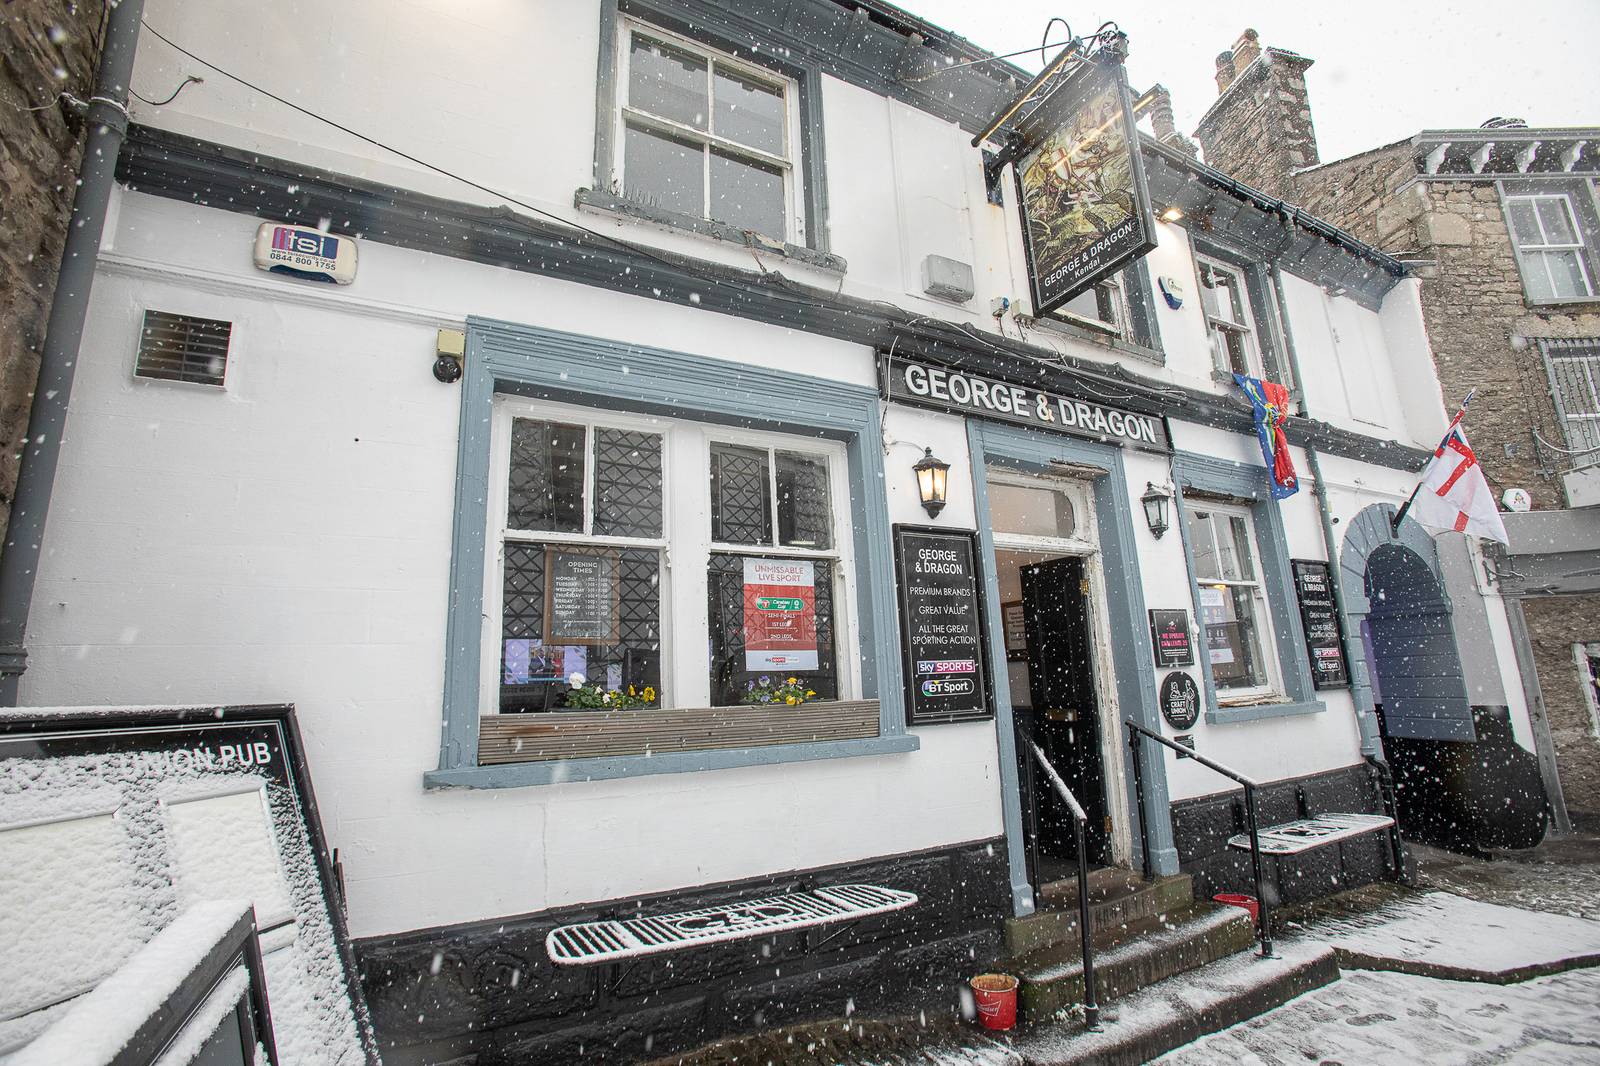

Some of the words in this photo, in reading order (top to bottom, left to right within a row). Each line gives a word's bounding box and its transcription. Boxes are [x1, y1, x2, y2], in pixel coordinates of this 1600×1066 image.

[288, 231, 325, 257] tsi
[270, 252, 292, 262] 0844
[295, 257, 312, 266] 800
[315, 261, 336, 271] 1755
[1044, 257, 1081, 287] GEORGE
[1081, 251, 1089, 263] &
[1090, 223, 1133, 257] DRAGON
[1074, 257, 1100, 278] Kendal
[904, 364, 1030, 417] GEORGE
[1035, 393, 1055, 422] &
[1058, 398, 1157, 443] DRAGON
[918, 548, 957, 562] GEORGE
[754, 564, 804, 575] UNMISSABLE
[915, 562, 923, 573] &
[924, 561, 963, 575] DRAGON
[758, 573, 775, 581] LIVE
[776, 574, 801, 582] SPORT
[909, 586, 942, 596] PREMIUM
[943, 587, 971, 597] BRANDS
[918, 606, 943, 615] GREAT
[943, 606, 966, 615] VALUE
[918, 624, 932, 633] ALL
[932, 624, 945, 633] THE
[946, 624, 969, 633] GREAT
[912, 635, 949, 645] SPORTING
[949, 635, 976, 645] ACTION
[919, 662, 934, 674] sky
[936, 660, 973, 672] SPORTS
[928, 683, 943, 693] BT
[943, 680, 968, 693] Sport
[219, 742, 271, 769] PUB
